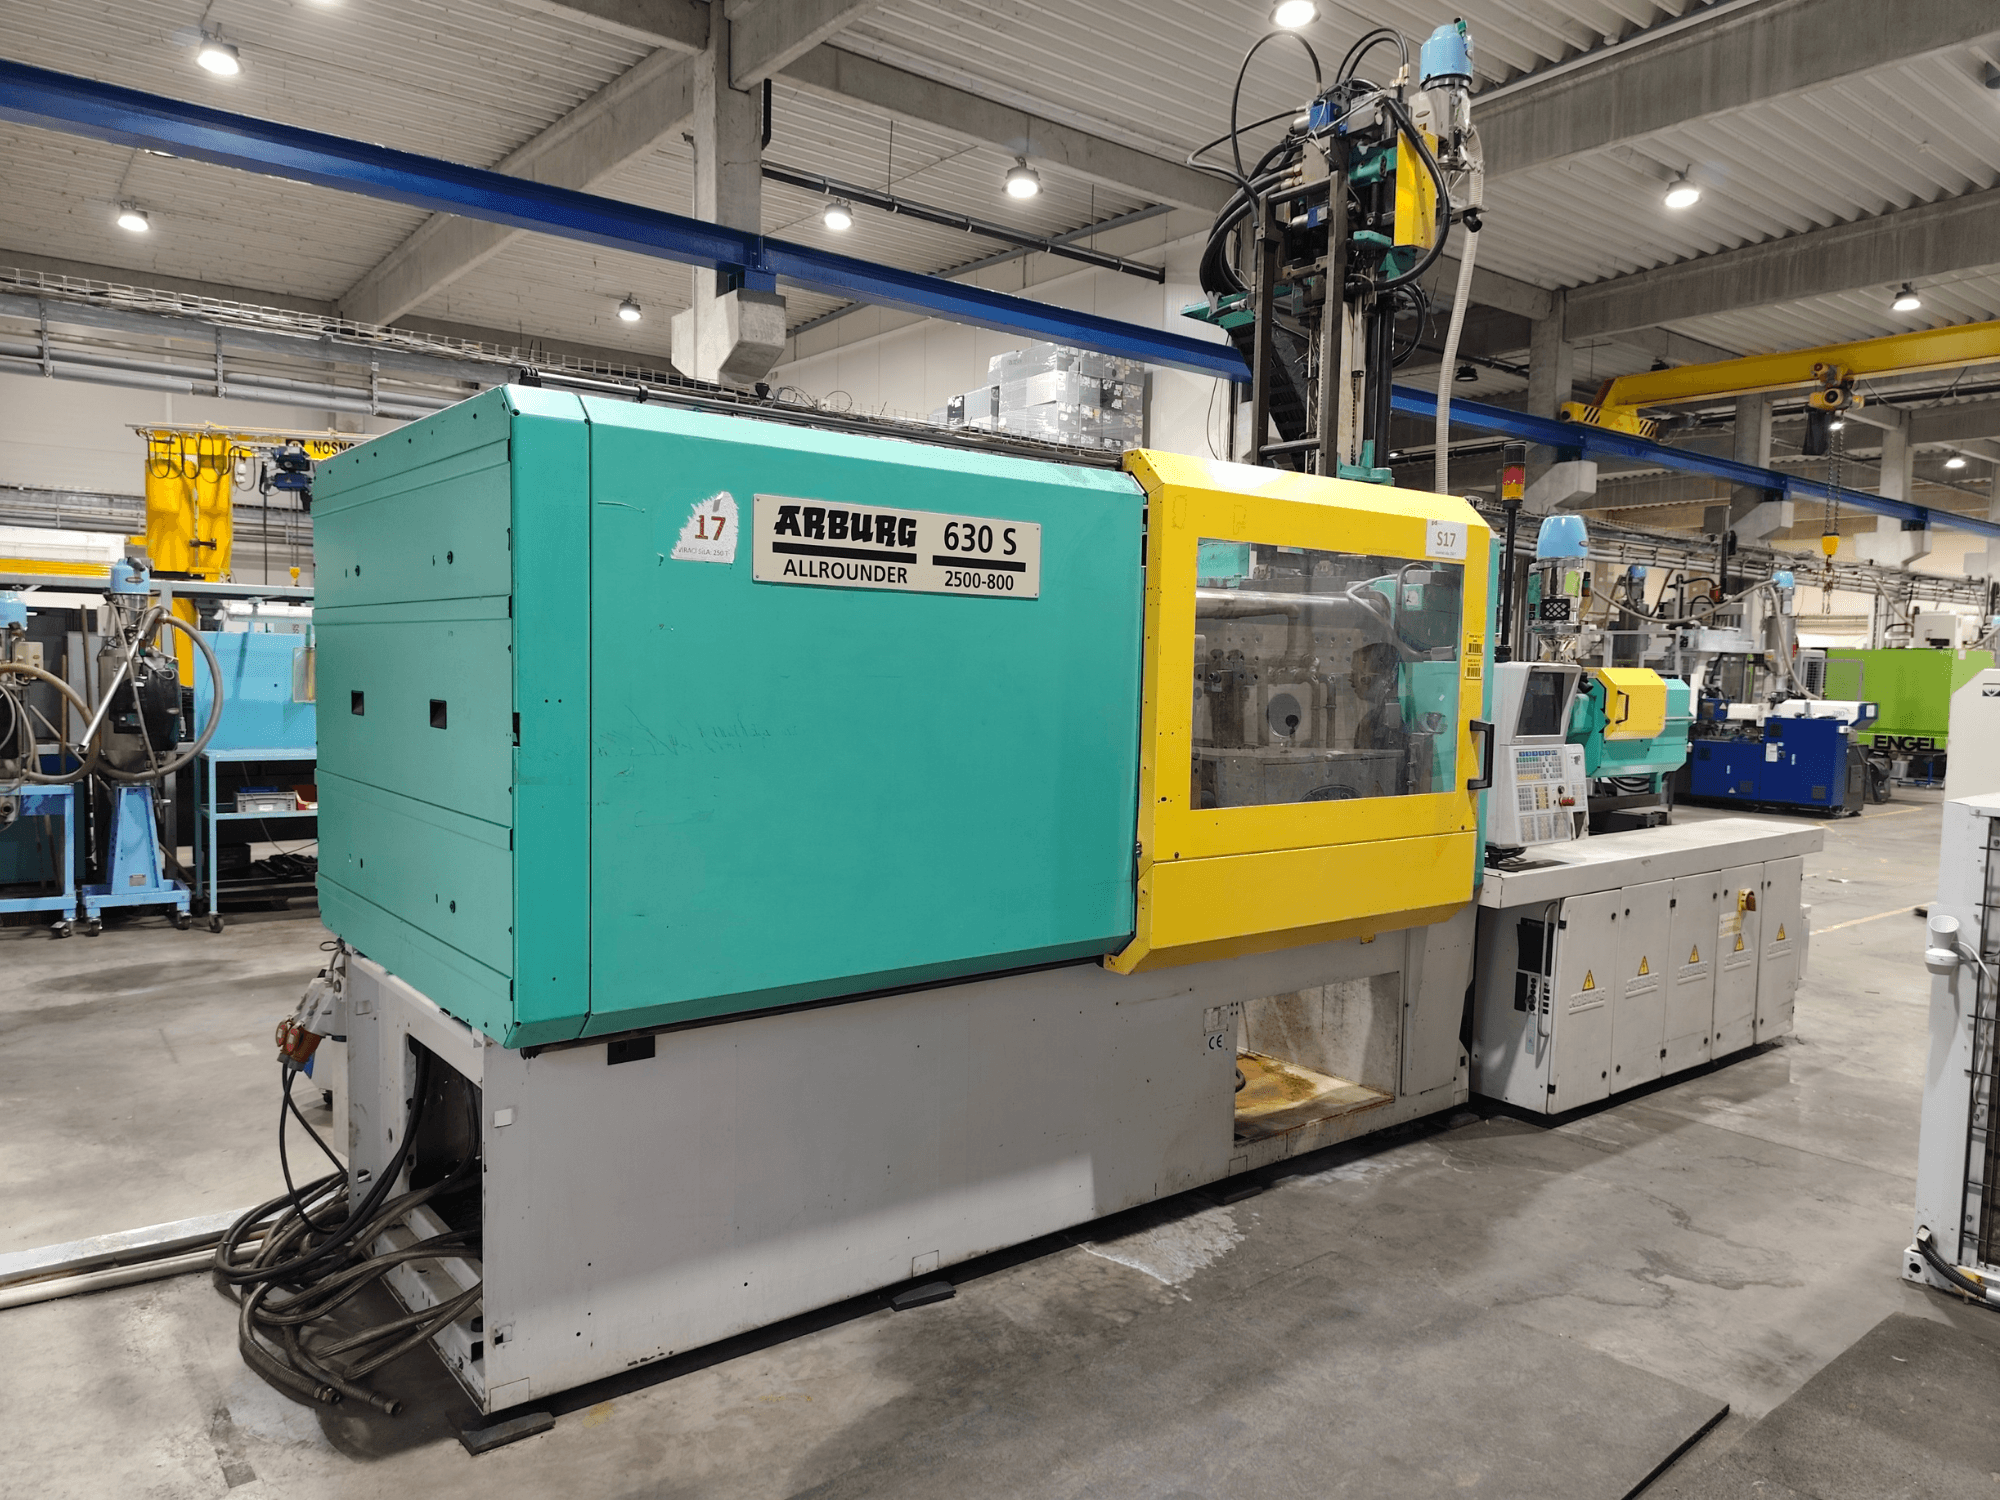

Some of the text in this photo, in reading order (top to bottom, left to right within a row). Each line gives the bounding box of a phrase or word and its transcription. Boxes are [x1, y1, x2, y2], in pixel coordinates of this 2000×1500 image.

[695, 514, 726, 541] 17
[774, 505, 917, 548] ARBURG
[944, 522, 1017, 555] 630 S
[1437, 531, 1456, 547] S17
[783, 559, 908, 583] ALLROUNDER
[945, 571, 1014, 590] 2500-800
[1873, 734, 1945, 752] ENGEL
[1209, 1034, 1222, 1050] CE
